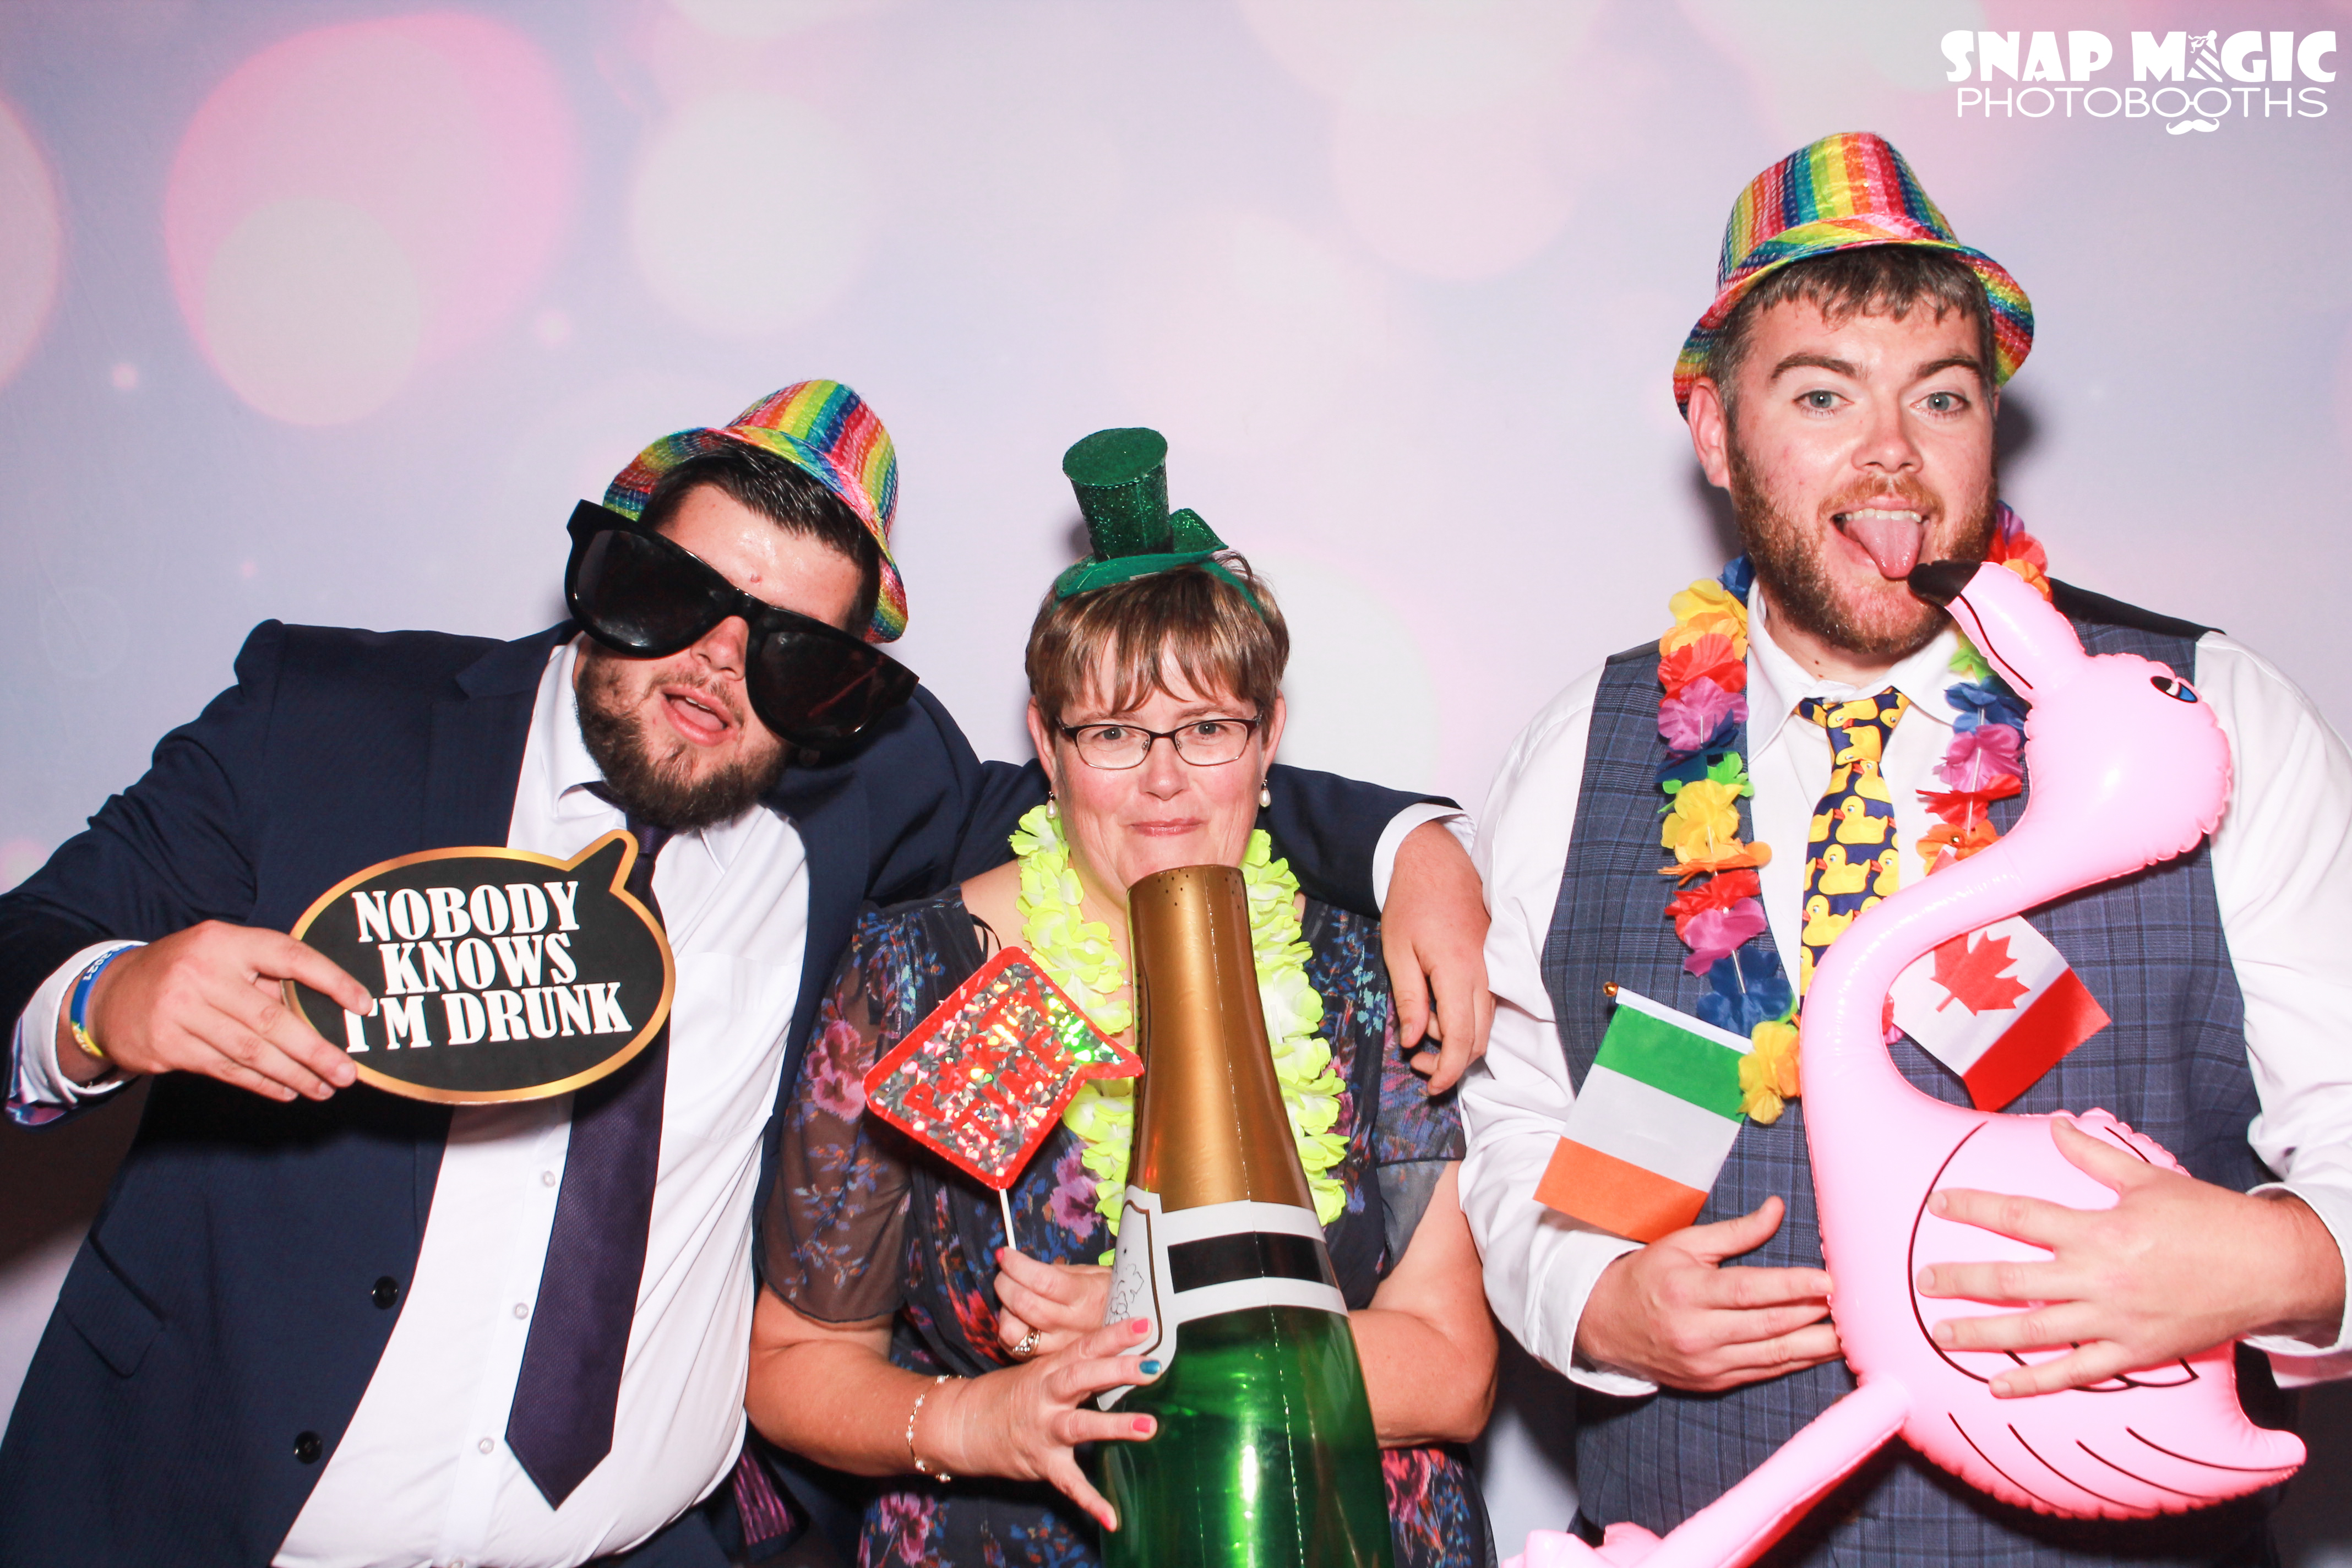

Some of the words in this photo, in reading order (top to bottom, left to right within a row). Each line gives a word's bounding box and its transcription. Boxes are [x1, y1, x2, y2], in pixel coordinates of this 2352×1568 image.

[352, 881, 580, 943] NOBODY
[379, 933, 577, 995] KNOWS
[344, 995, 432, 1053] I'M
[441, 982, 633, 1045] DRUNK
